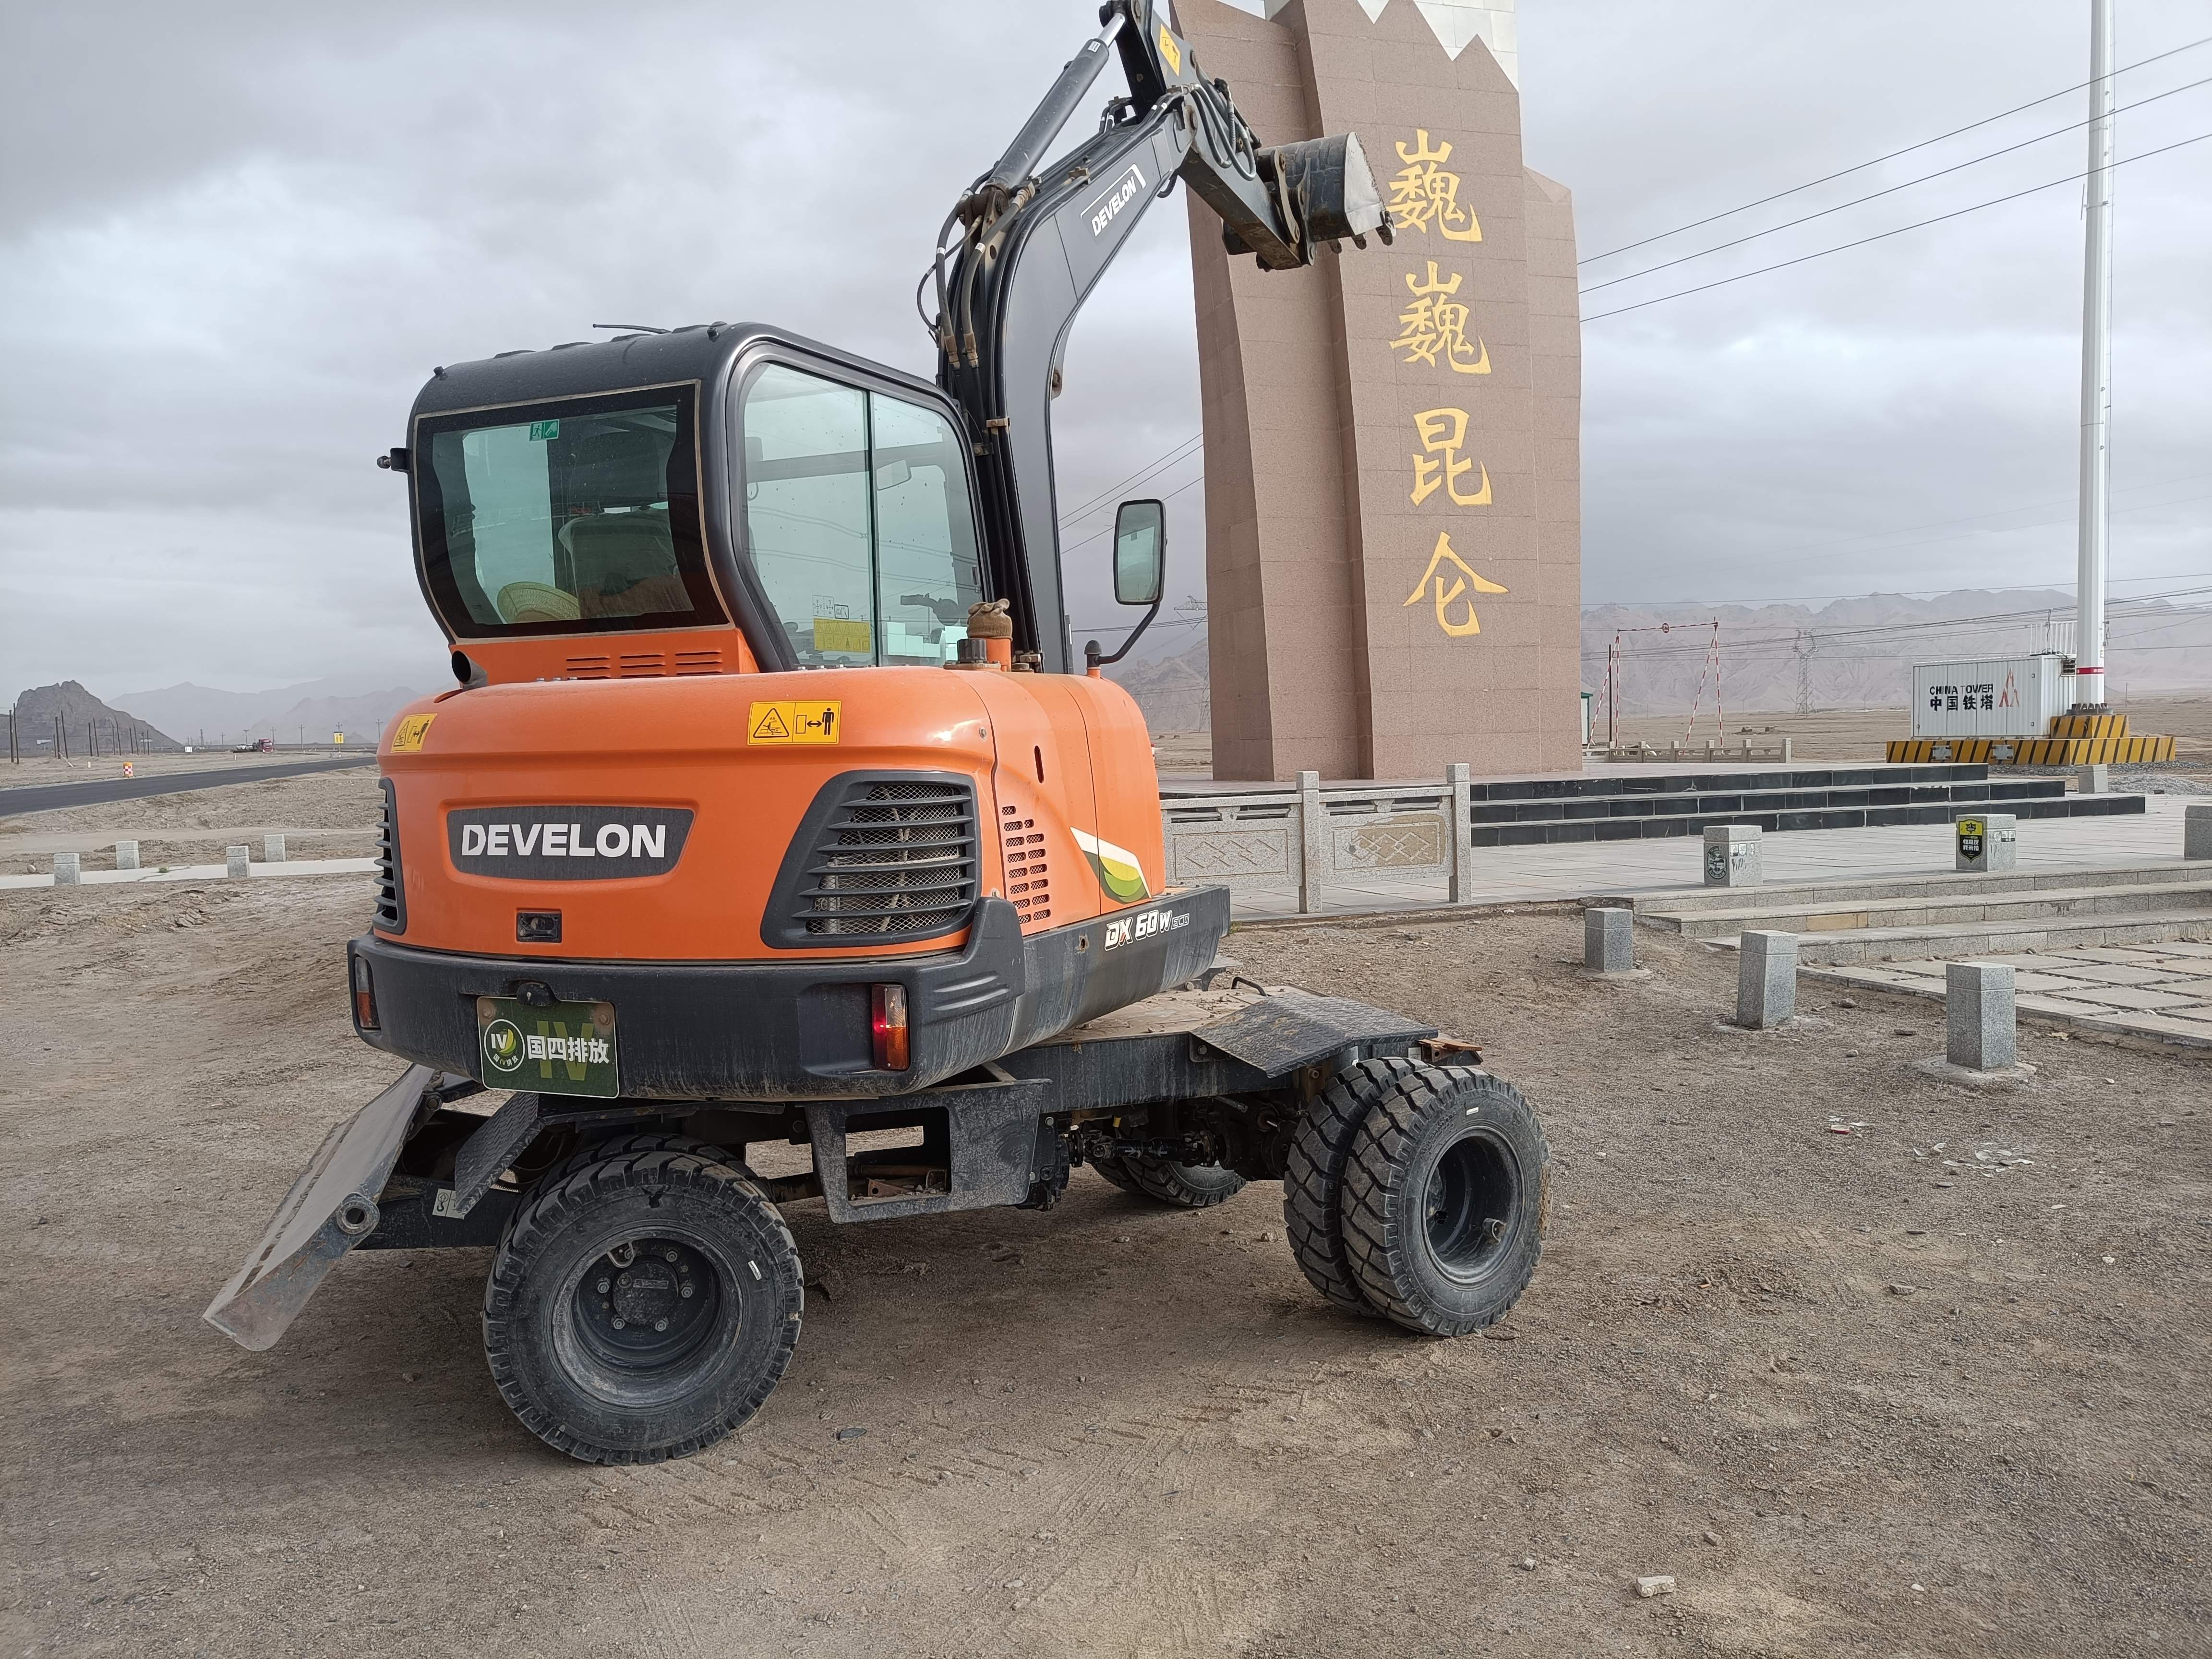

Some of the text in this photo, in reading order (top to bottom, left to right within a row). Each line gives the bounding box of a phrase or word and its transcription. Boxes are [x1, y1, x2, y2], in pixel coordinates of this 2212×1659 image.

[1091, 176, 1137, 237] DEVELON
[1387, 128, 1510, 637] 巍巍昆仑
[1930, 684, 1994, 695] CHINA TOWER
[1930, 695, 1993, 711] 中国铁塔
[461, 823, 666, 858] DEVELON
[1105, 916, 1133, 951] DX
[1171, 913, 1190, 930] ECO
[491, 1034, 507, 1049] IV
[527, 1034, 610, 1064] 国四排放
